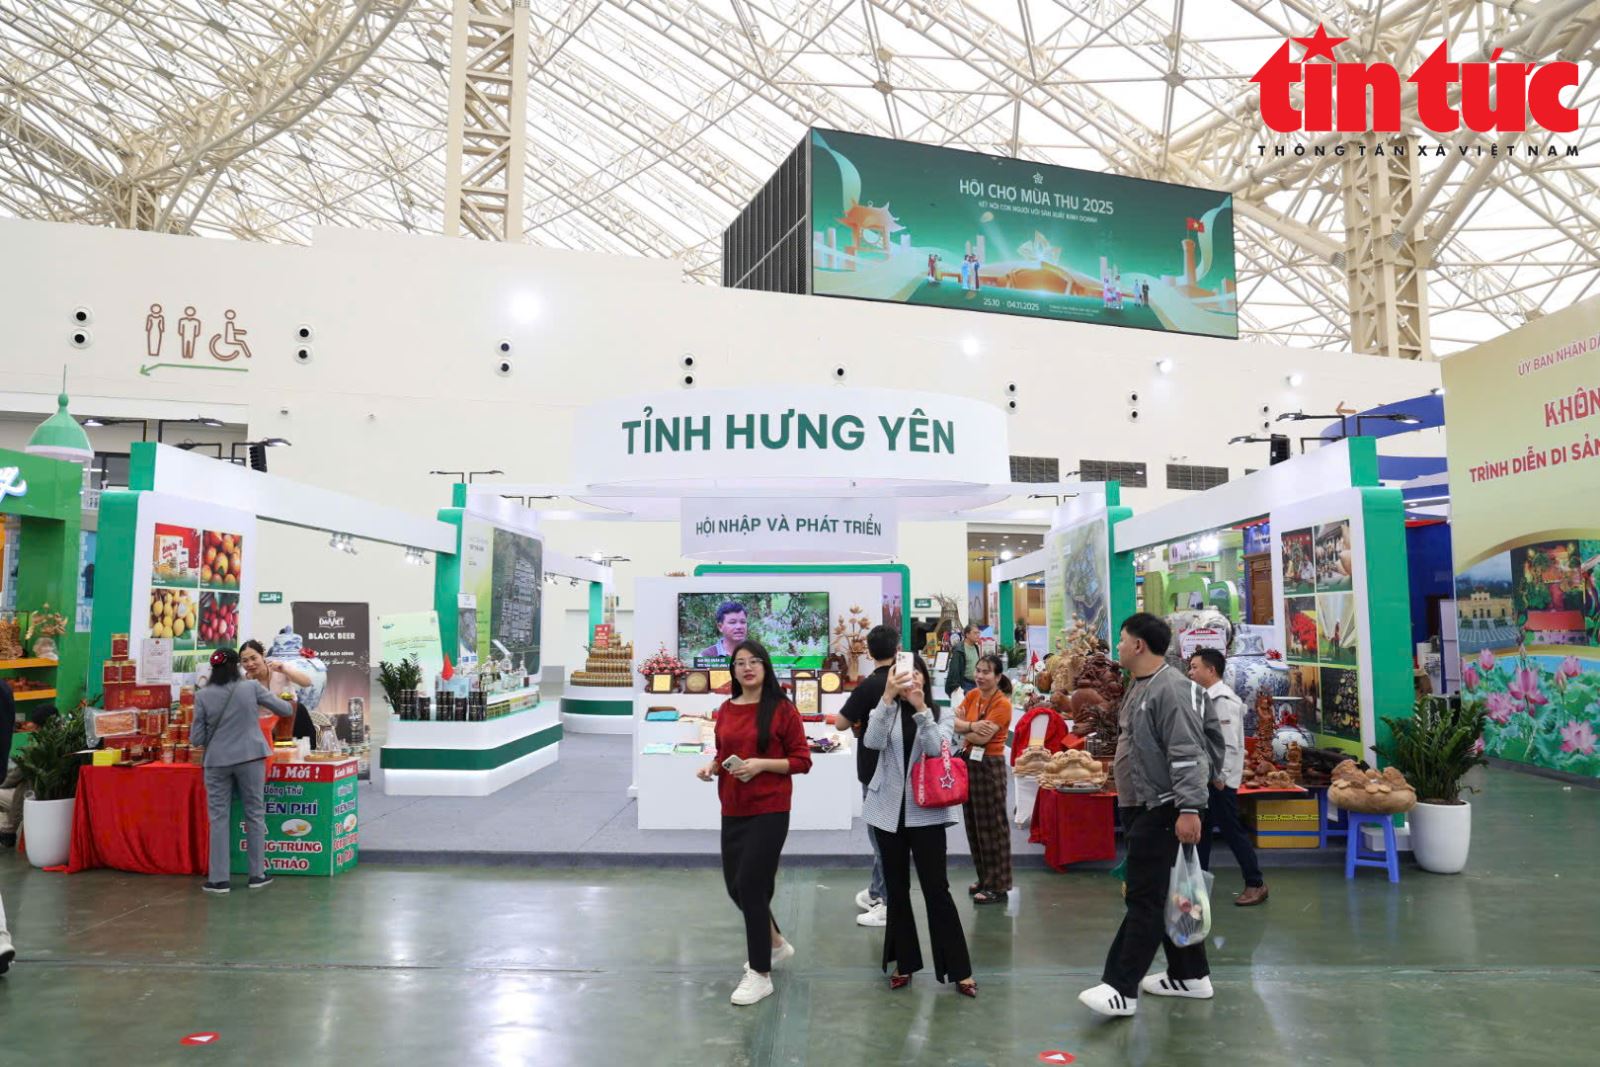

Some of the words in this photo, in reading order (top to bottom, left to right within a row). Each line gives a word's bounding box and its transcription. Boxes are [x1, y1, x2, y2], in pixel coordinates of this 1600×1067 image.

[959, 178, 984, 197] HỘI
[988, 184, 1017, 202] CHỢ
[1021, 187, 1051, 206] MÙA
[1053, 193, 1079, 210] THU
[1083, 198, 1114, 215] 2025
[1006, 300, 1040, 311] 04.11.2025
[1534, 353, 1554, 371] BAN
[1556, 339, 1587, 362] NHÂN
[622, 405, 711, 454] TỈNH
[726, 408, 865, 450] HƯNG
[878, 407, 955, 454] YÊN
[1469, 460, 1509, 483] TRÌNH
[1512, 446, 1546, 474] DIỄN
[1551, 446, 1567, 466] DI
[695, 516, 715, 537] HỘI
[718, 514, 761, 536] NHẬP
[766, 516, 790, 533] VÀ
[795, 516, 839, 533] PHÁT
[843, 513, 881, 537] TRIỂN
[308, 632, 335, 640] BLACK
[337, 632, 356, 640] BEER
[284, 765, 312, 779] Mời
[290, 799, 318, 815] PHÍ
